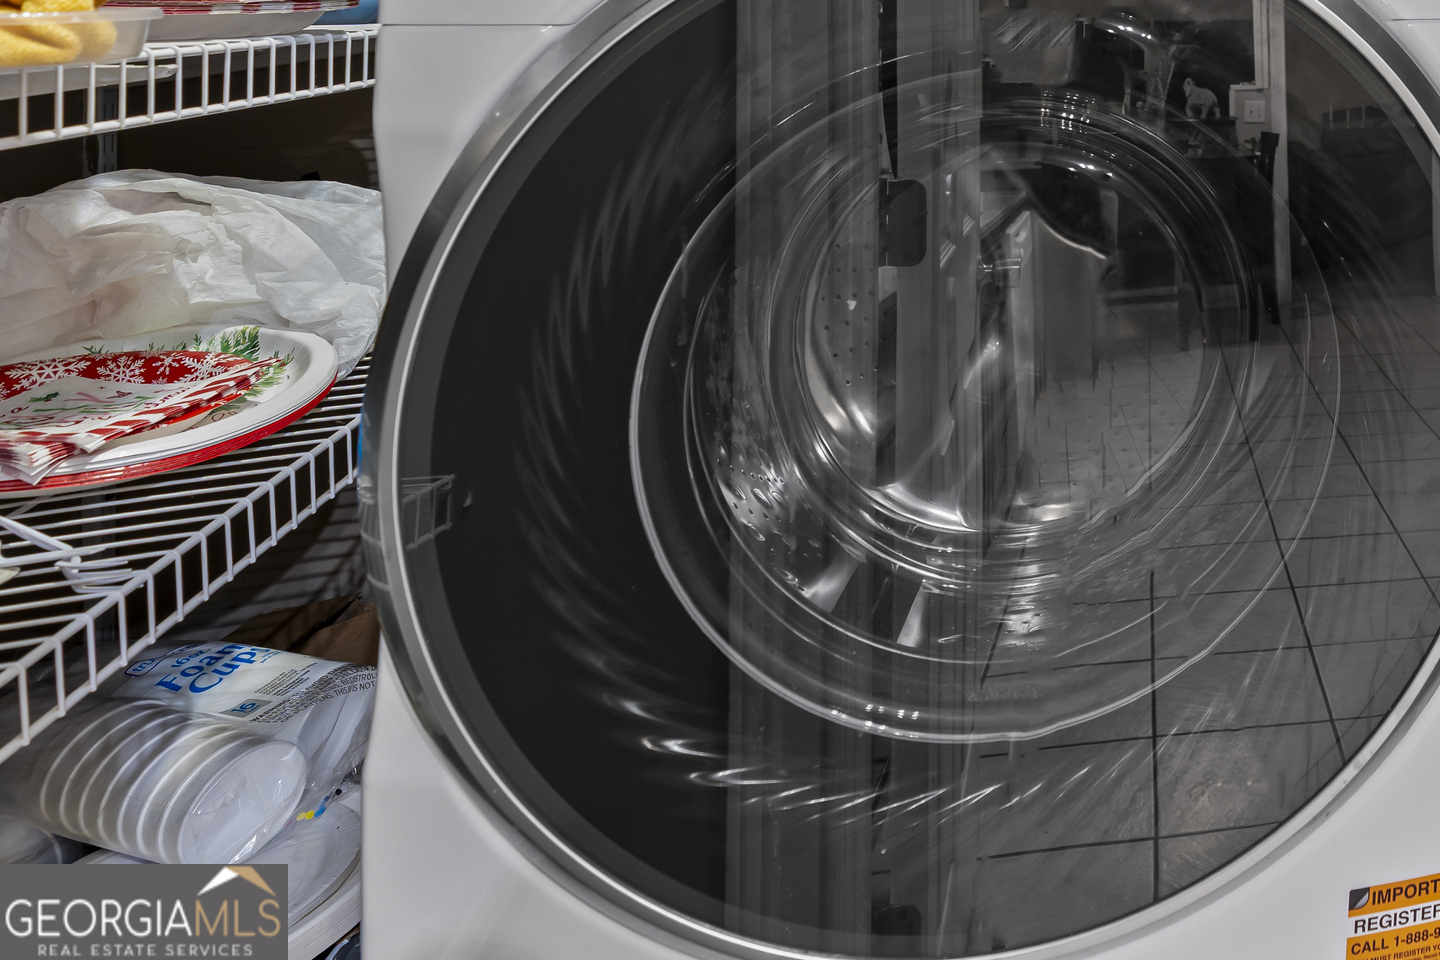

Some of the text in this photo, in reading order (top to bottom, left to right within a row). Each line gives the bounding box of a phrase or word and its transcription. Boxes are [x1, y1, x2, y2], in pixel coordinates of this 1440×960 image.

[359, 680, 375, 691] NOT
[1351, 938, 1389, 955] CALL
[1393, 946, 1431, 959] REGISTER
